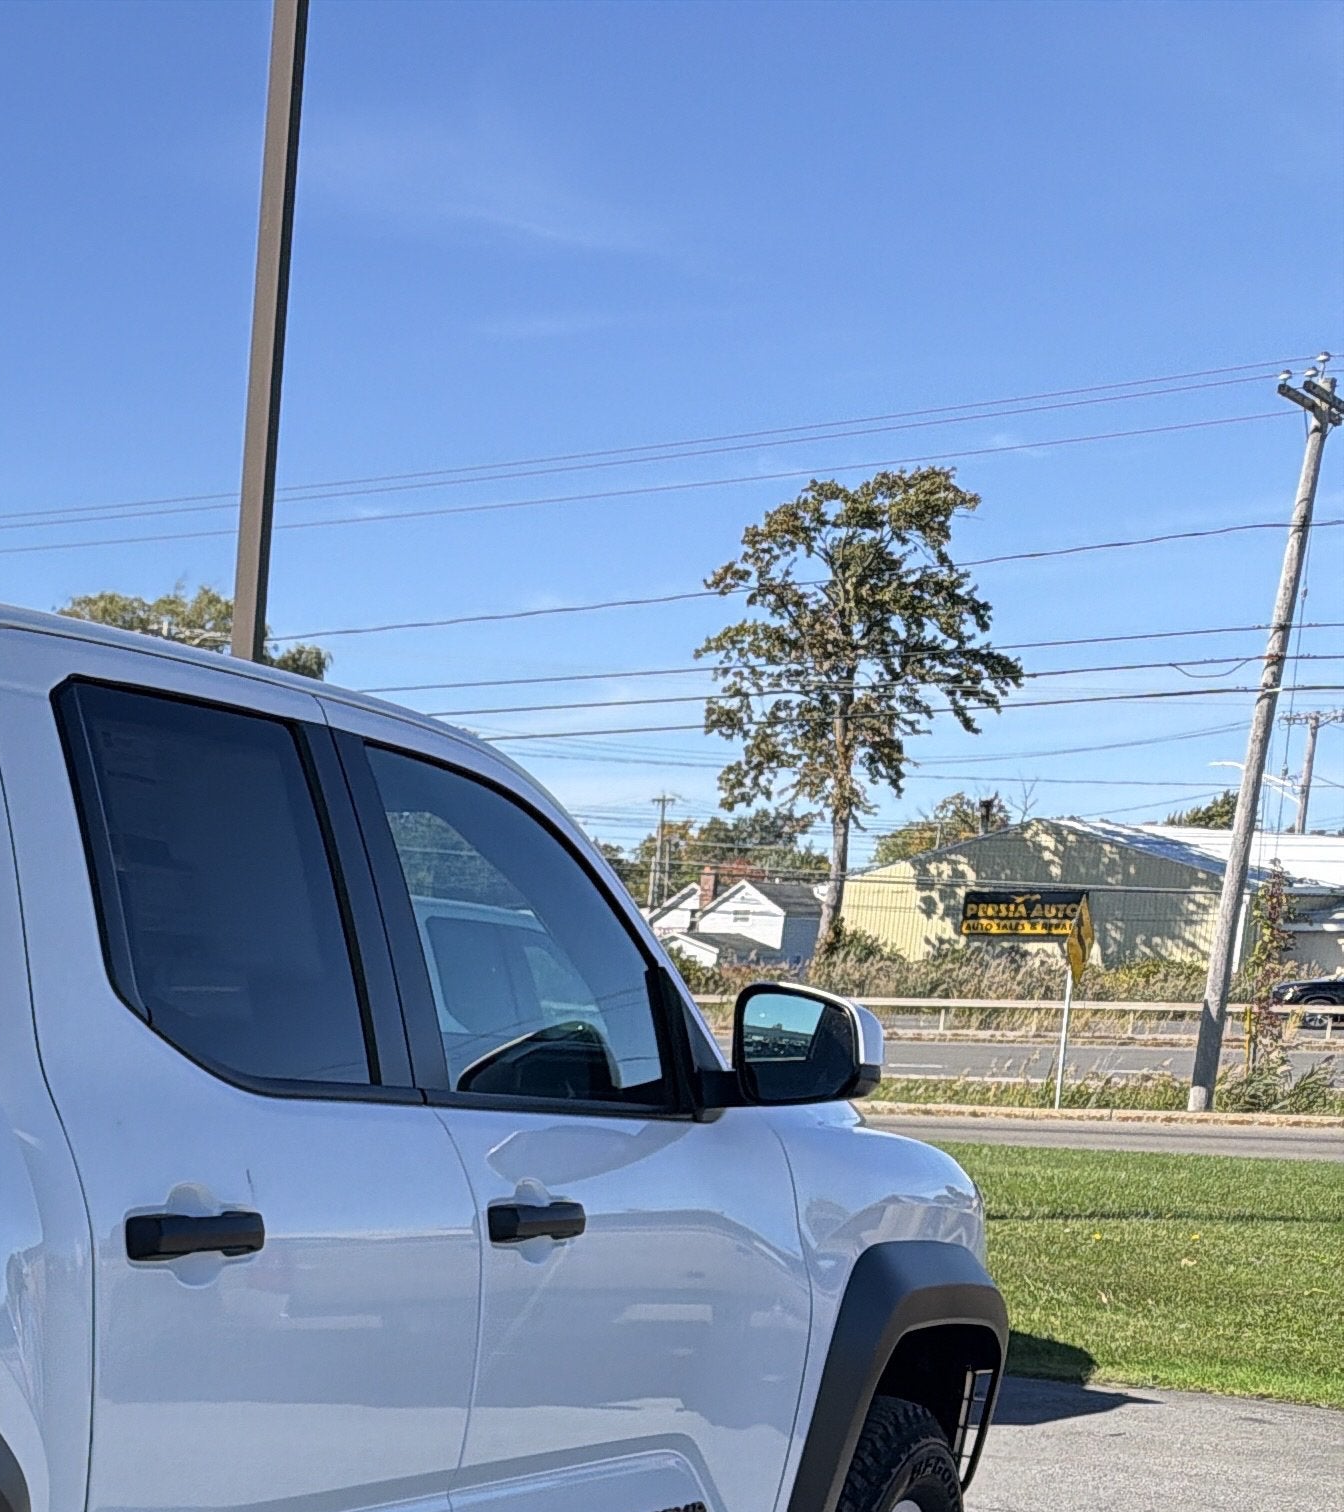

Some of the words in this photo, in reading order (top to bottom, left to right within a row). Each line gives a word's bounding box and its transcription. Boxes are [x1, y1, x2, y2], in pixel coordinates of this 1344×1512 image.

[966, 903, 1027, 918] PERSIA
[1030, 903, 1078, 918] AUTO
[964, 922, 993, 931] AUTO
